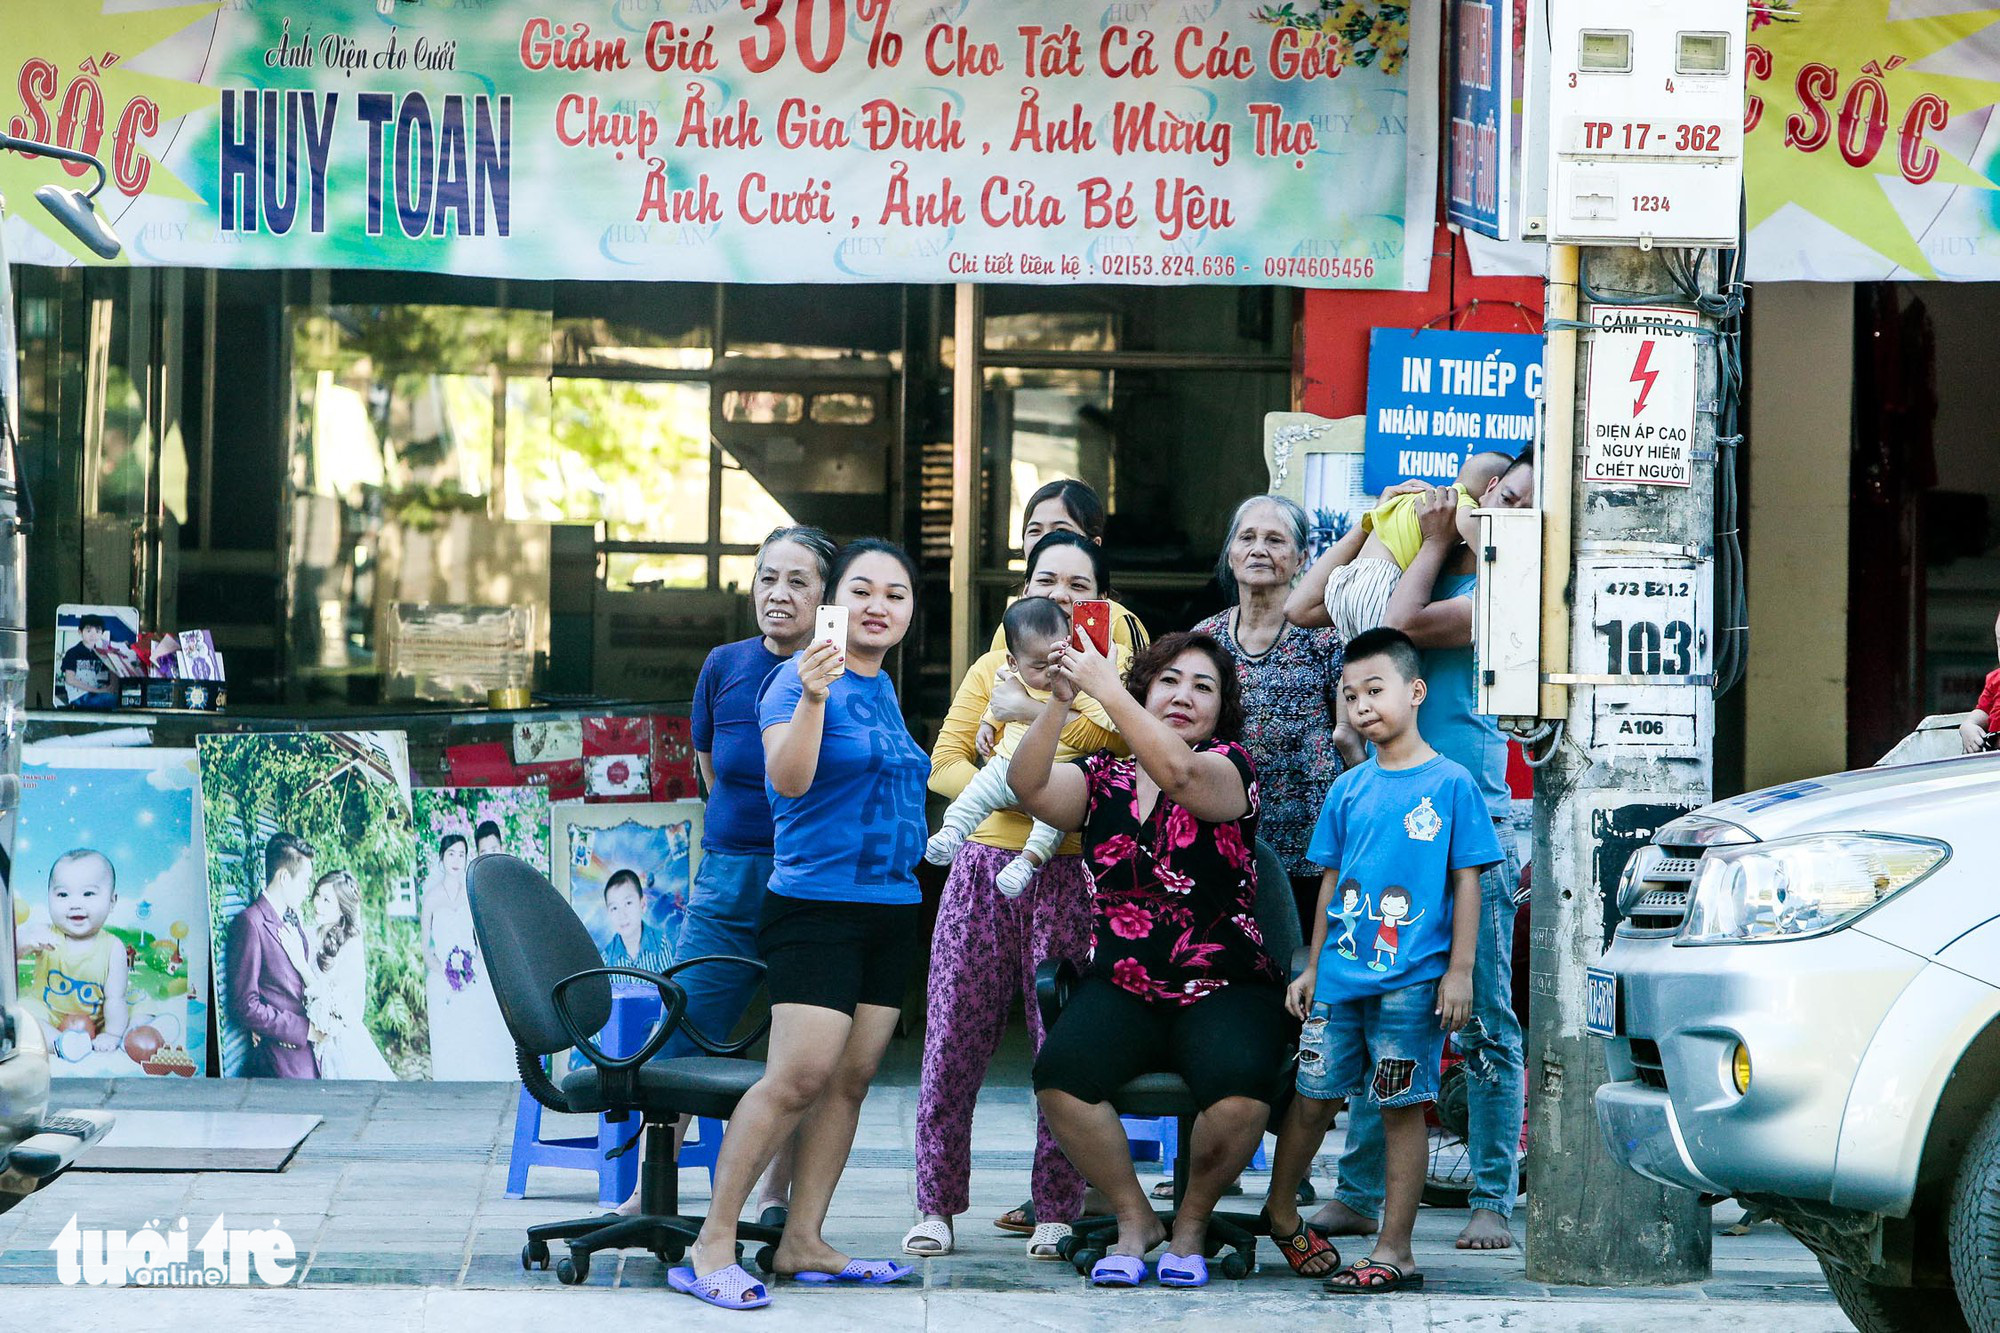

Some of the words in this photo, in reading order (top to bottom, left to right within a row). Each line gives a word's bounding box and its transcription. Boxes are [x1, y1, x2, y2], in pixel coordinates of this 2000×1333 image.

[265, 17, 313, 67] Ảnh
[319, 33, 368, 78] Viện
[373, 26, 408, 70] Áo
[414, 36, 456, 71] Cưới
[521, 18, 630, 72] Giảm
[645, 20, 718, 72] Giá
[739, 0, 902, 73] 30%
[925, 23, 1003, 77] Cho
[1018, 24, 1085, 78] Tất
[1100, 25, 1158, 79] Cả
[1174, 26, 1255, 80] Các
[1269, 28, 1342, 81] Gói
[1568, 73, 1577, 88] 3
[1665, 79, 1674, 93] 4
[556, 93, 658, 161] Chụp
[676, 83, 762, 150] Ảnh
[777, 98, 850, 151] Gia
[861, 98, 965, 152] Đình
[1010, 86, 1096, 155] Ảnh
[1112, 101, 1231, 166] Mừng
[1249, 103, 1318, 169] Thọ
[1785, 54, 1950, 185] SỐC
[1584, 122, 1613, 149] TP
[1622, 123, 1651, 150] 17
[1676, 125, 1721, 151] 362
[220, 90, 338, 234] HUY
[357, 92, 511, 238] TOAN
[636, 158, 723, 224] Ảnh
[738, 172, 835, 225] Cưới
[880, 160, 966, 228] Ảnh
[981, 175, 1066, 229] Của
[1078, 177, 1138, 230] Bé
[1155, 177, 1235, 241] Yêu
[1632, 196, 1671, 213] 1234
[949, 252, 978, 274] Chi
[984, 253, 1014, 275] tiết
[1021, 254, 1057, 277] liên
[1061, 254, 1082, 281] hệ
[1102, 255, 1235, 277] 02153.824.636
[1264, 257, 1375, 278] 0974605456
[1402, 356, 1432, 394] IN
[1439, 349, 1517, 398] THIẾP
[1378, 404, 1429, 441] NHẬN
[1432, 406, 1481, 439] ĐÓNG
[1485, 414, 1534, 441] KHUN
[1635, 423, 1655, 439] ÁP
[1659, 427, 1687, 442] CAO
[1398, 450, 1459, 478] KHUNG
[1602, 444, 1643, 458] NGUY
[1639, 464, 1684, 480] NGƯỜI
[1606, 582, 1639, 596] 473
[1594, 619, 1692, 675] 103
